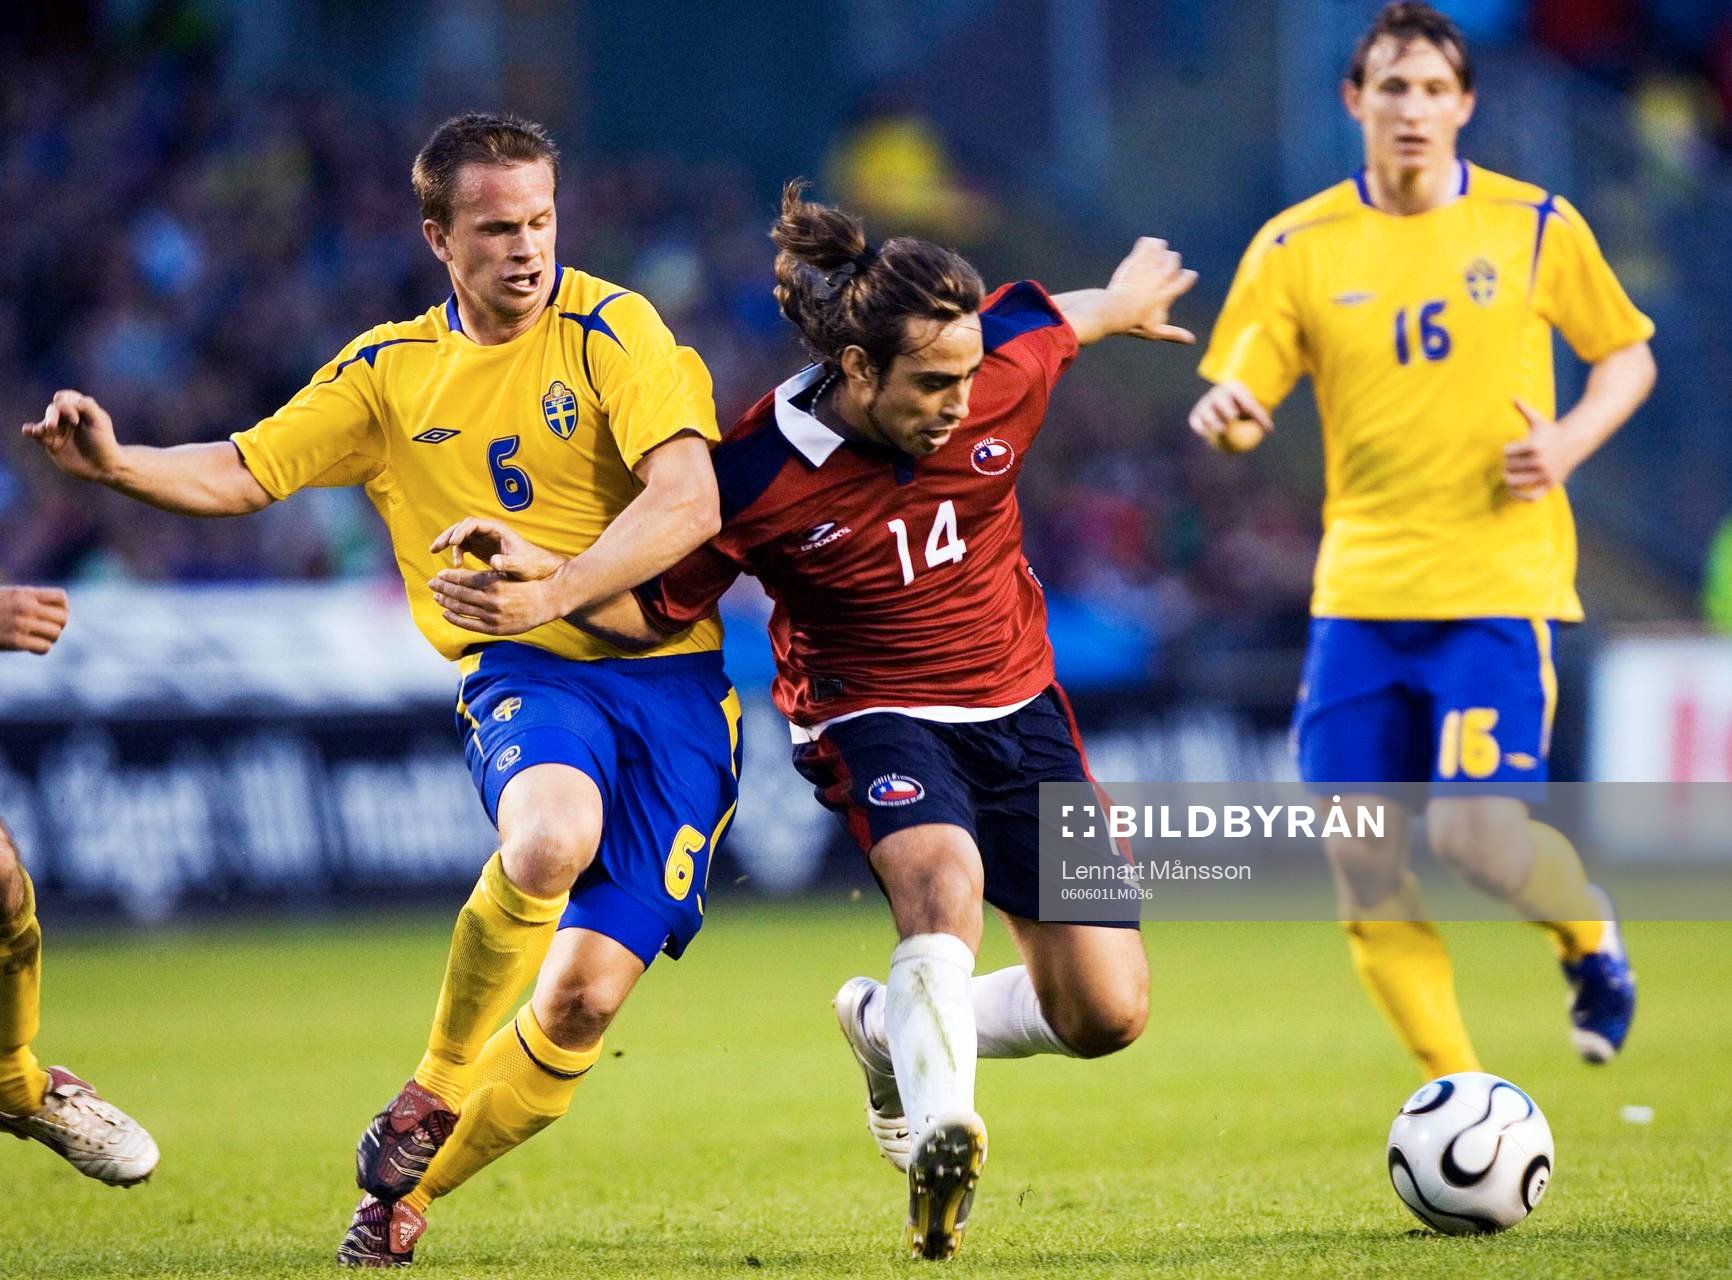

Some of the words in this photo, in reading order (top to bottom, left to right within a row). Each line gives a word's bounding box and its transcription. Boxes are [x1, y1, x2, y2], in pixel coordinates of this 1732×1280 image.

[1395, 301, 1451, 366] 16
[486, 434, 534, 512] 6
[887, 499, 967, 586] 14
[1438, 706, 1500, 780] 16
[664, 823, 706, 901] 6
